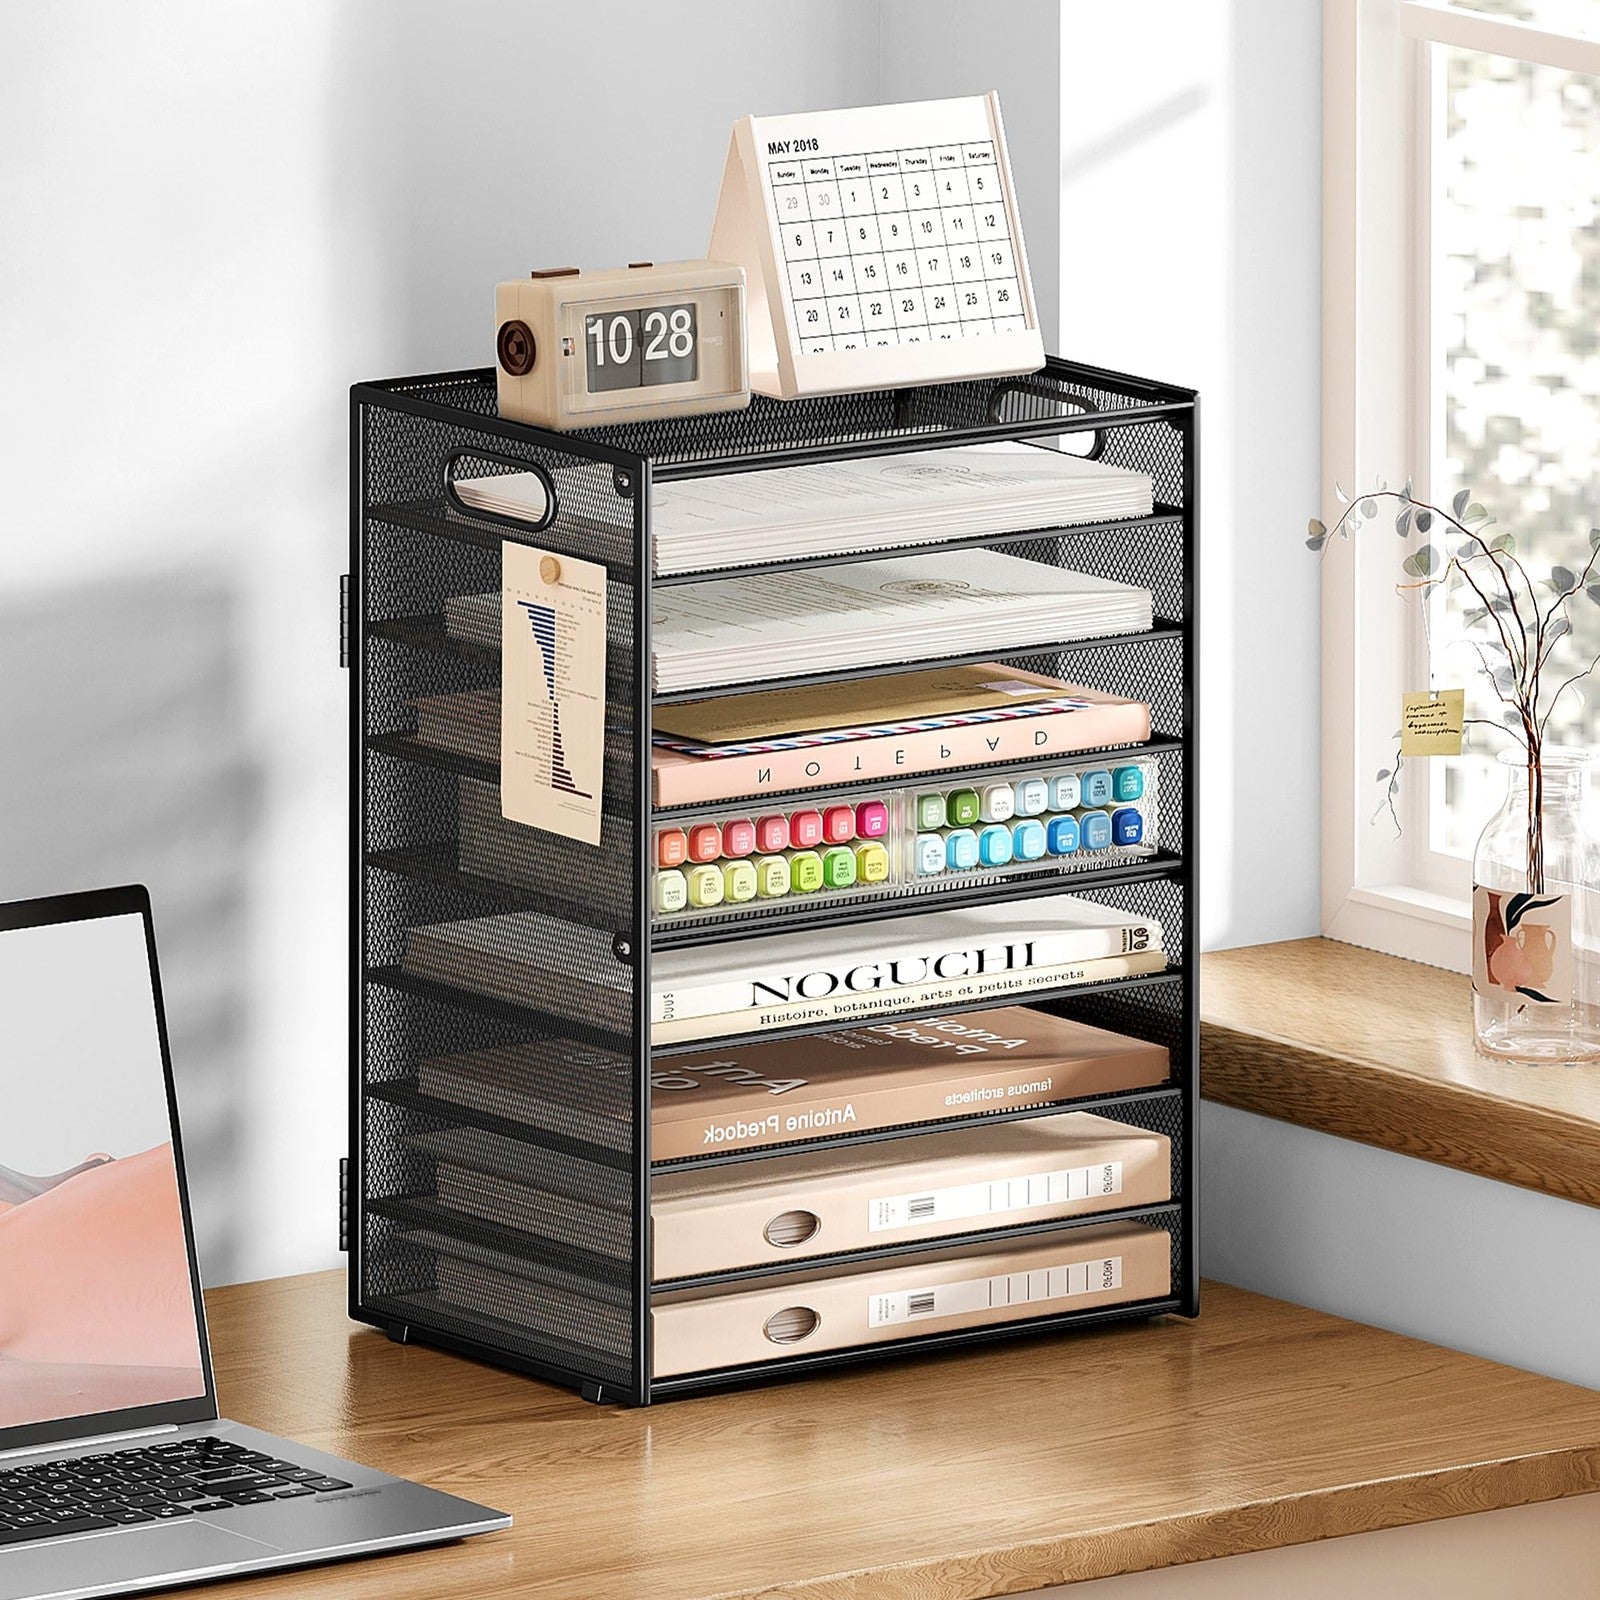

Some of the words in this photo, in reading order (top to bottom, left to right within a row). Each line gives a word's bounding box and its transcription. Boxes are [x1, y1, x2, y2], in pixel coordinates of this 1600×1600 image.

[768, 141, 790, 155] MAY
[793, 138, 819, 153] 2018
[786, 197, 797, 209] 29
[819, 194, 829, 205] 30
[851, 192, 856, 202] 1
[881, 188, 889, 199] 2
[913, 185, 921, 196] 3
[946, 181, 953, 192] 4
[976, 178, 984, 189] 5
[795, 235, 803, 246] 6
[827, 231, 833, 242] 7
[859, 228, 867, 239] 8
[891, 225, 898, 236] 9
[922, 221, 932, 233] 10
[953, 219, 963, 229] 11
[985, 215, 995, 226] 12
[801, 273, 811, 284] 13
[833, 270, 843, 281] 14
[865, 266, 876, 277] 15
[897, 262, 907, 274] 16
[928, 259, 937, 270] 17
[960, 256, 971, 268] 18
[992, 253, 1002, 264] 19
[807, 310, 818, 322] 20
[838, 307, 849, 318] 21
[870, 303, 882, 315] 22
[902, 300, 914, 312] 23
[935, 297, 945, 309] 24
[966, 293, 977, 305] 25
[998, 290, 1009, 301] 26
[588, 316, 633, 366] 10
[645, 309, 694, 360] 28
[748, 942, 1036, 1007] NOGUCHI
[760, 1008, 828, 1024] Histoire,
[834, 995, 915, 1014] botanique,
[920, 989, 952, 1001] arts
[958, 986, 974, 996] et
[978, 979, 1023, 994] petits
[1028, 969, 1085, 984] secrets
